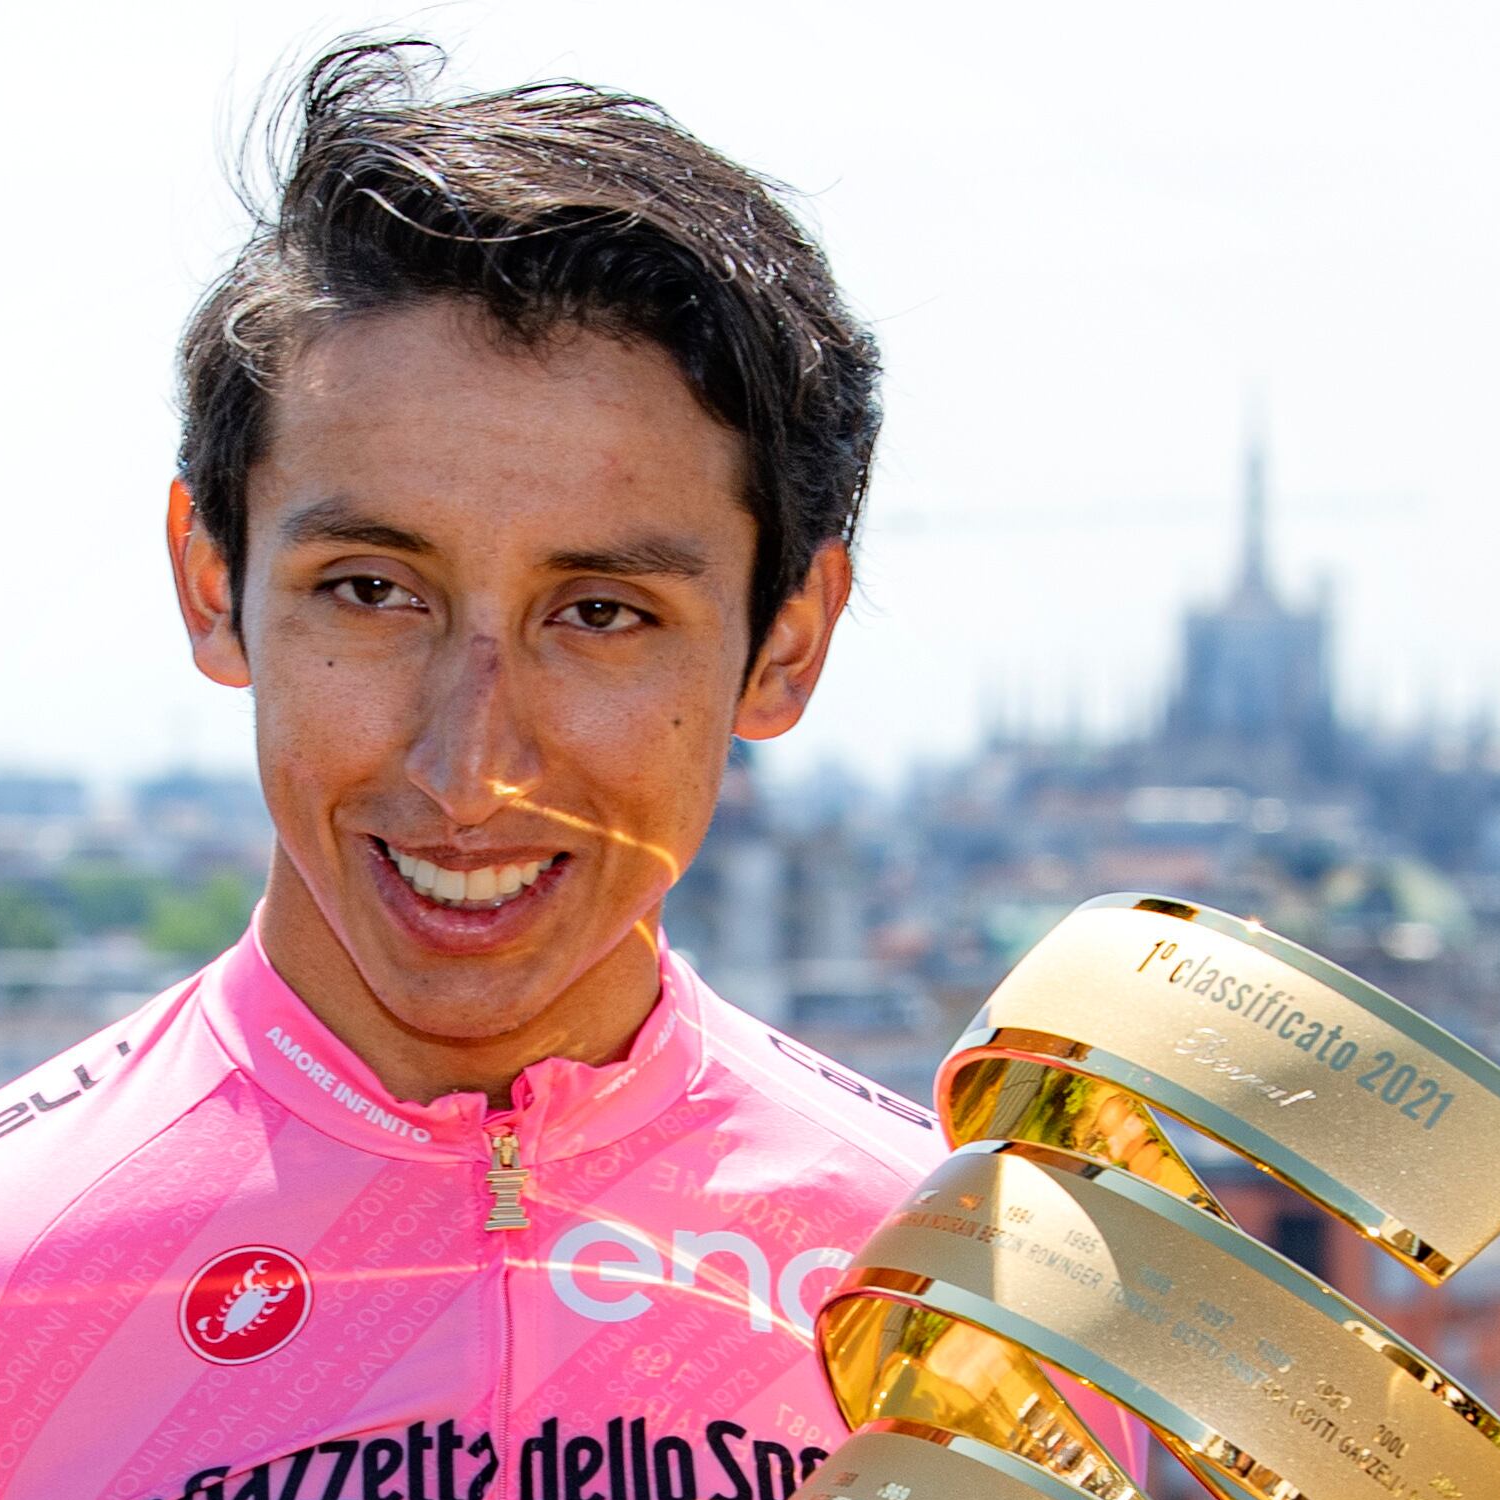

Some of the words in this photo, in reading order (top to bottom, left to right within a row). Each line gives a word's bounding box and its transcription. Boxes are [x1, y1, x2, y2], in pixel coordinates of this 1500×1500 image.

[1168, 952, 1359, 1072] classificato
[1357, 1050, 1456, 1132] 2021
[261, 1022, 340, 1092] AMORE
[331, 1082, 433, 1145] INFINITO
[345, 1166, 409, 1233] 2015
[77, 1233, 130, 1294] 1912
[1026, 1241, 1105, 1291] ROMINGER
[1062, 1227, 1102, 1257] 1995
[98, 1248, 163, 1322] HART
[259, 1329, 312, 1385] 2011
[316, 1181, 447, 1322] SCARPONI
[241, 1421, 276, 1457] DI
[269, 1351, 340, 1427] LUCA
[346, 1271, 411, 1341] 2006
[704, 1363, 761, 1418] 1973
